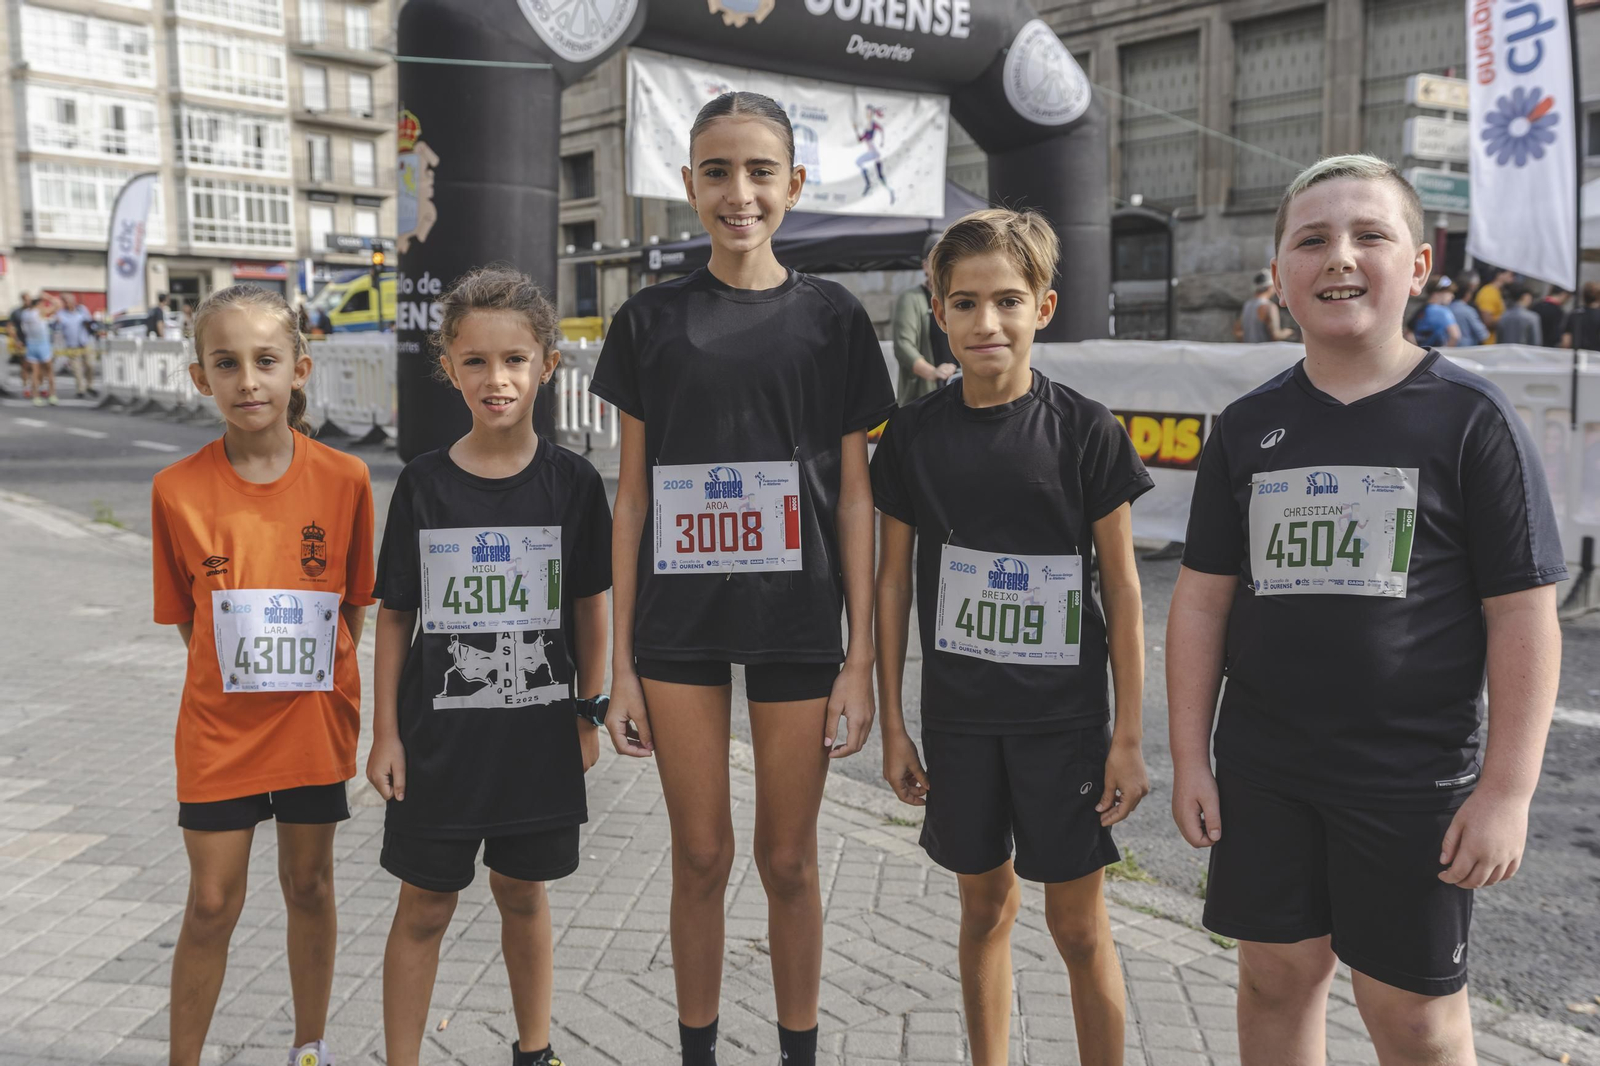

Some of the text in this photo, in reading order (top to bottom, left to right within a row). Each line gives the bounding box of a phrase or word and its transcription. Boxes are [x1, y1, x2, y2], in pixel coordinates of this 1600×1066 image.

[846, 34, 915, 62] Deportes
[417, 271, 442, 295] de
[1113, 415, 1201, 463] DIS
[663, 479, 693, 490] 2026
[704, 480, 743, 491] correndo
[1258, 481, 1289, 495] 2026
[1306, 485, 1311, 495] a
[705, 501, 729, 510] AROA
[1283, 505, 1343, 518] CHRISTIAN
[676, 511, 763, 554] 3008
[429, 544, 460, 554] 2026
[471, 545, 511, 555] correndo
[1266, 520, 1364, 568] 4504
[206, 568, 228, 577] umbro
[472, 564, 496, 573] MIGU
[949, 560, 977, 574] 2026
[988, 570, 1029, 583] correndo
[442, 574, 529, 614] 4304
[981, 590, 1019, 602] BREIXO
[264, 606, 303, 616] correndo
[955, 597, 1045, 645] 4009
[264, 626, 288, 634] LARA
[234, 636, 317, 675] 4308
[959, 645, 982, 655] OURENSE
[516, 695, 539, 704] 2025
